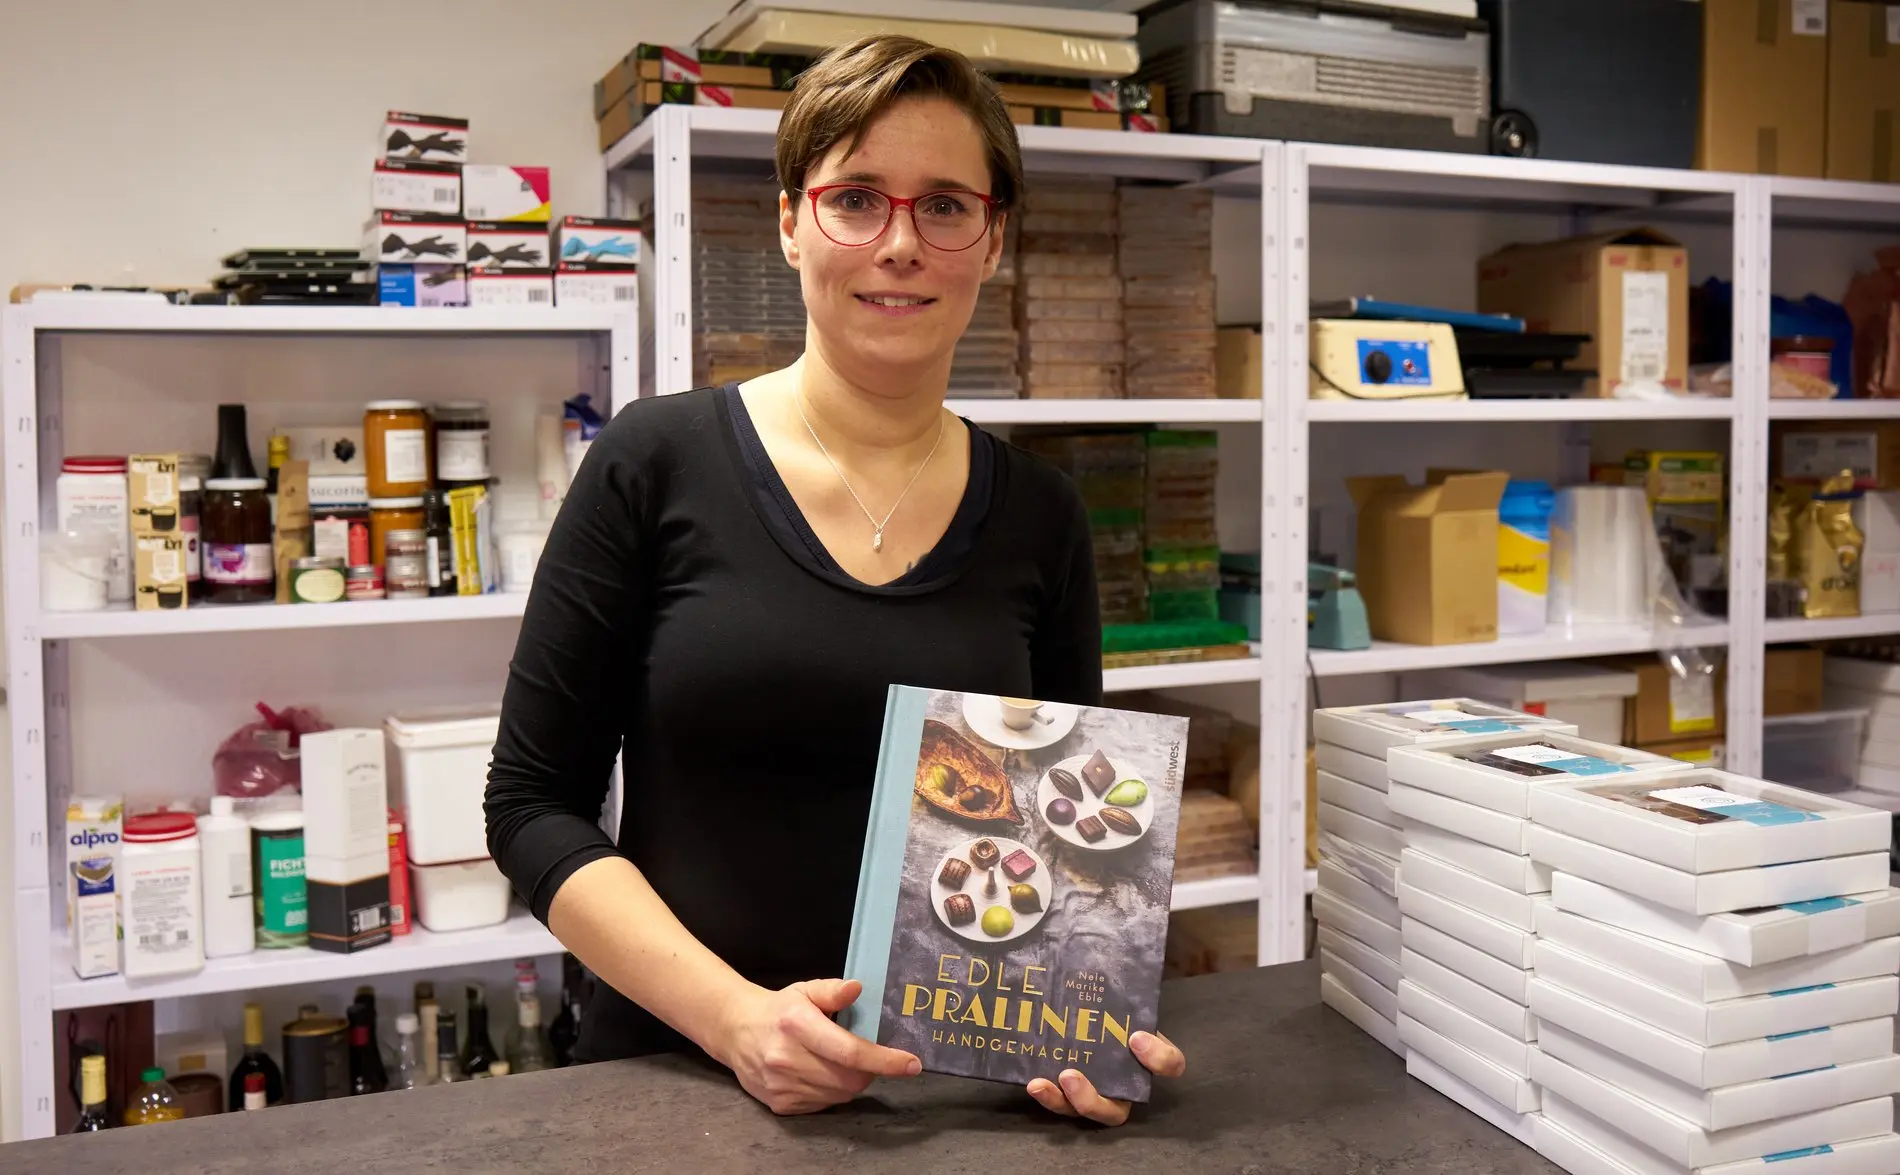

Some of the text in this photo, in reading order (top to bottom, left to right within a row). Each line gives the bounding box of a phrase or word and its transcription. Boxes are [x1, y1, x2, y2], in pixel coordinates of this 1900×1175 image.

[1164, 740, 1180, 792] südwest
[70, 829, 119, 849] alpro
[937, 953, 1047, 996] EDLE
[1065, 980, 1105, 993] Marike
[1078, 971, 1105, 982] Nele
[1078, 991, 1103, 1003] Eble
[901, 983, 1131, 1048] PRALINEN
[932, 1029, 1094, 1065] HANDGEMACHT
